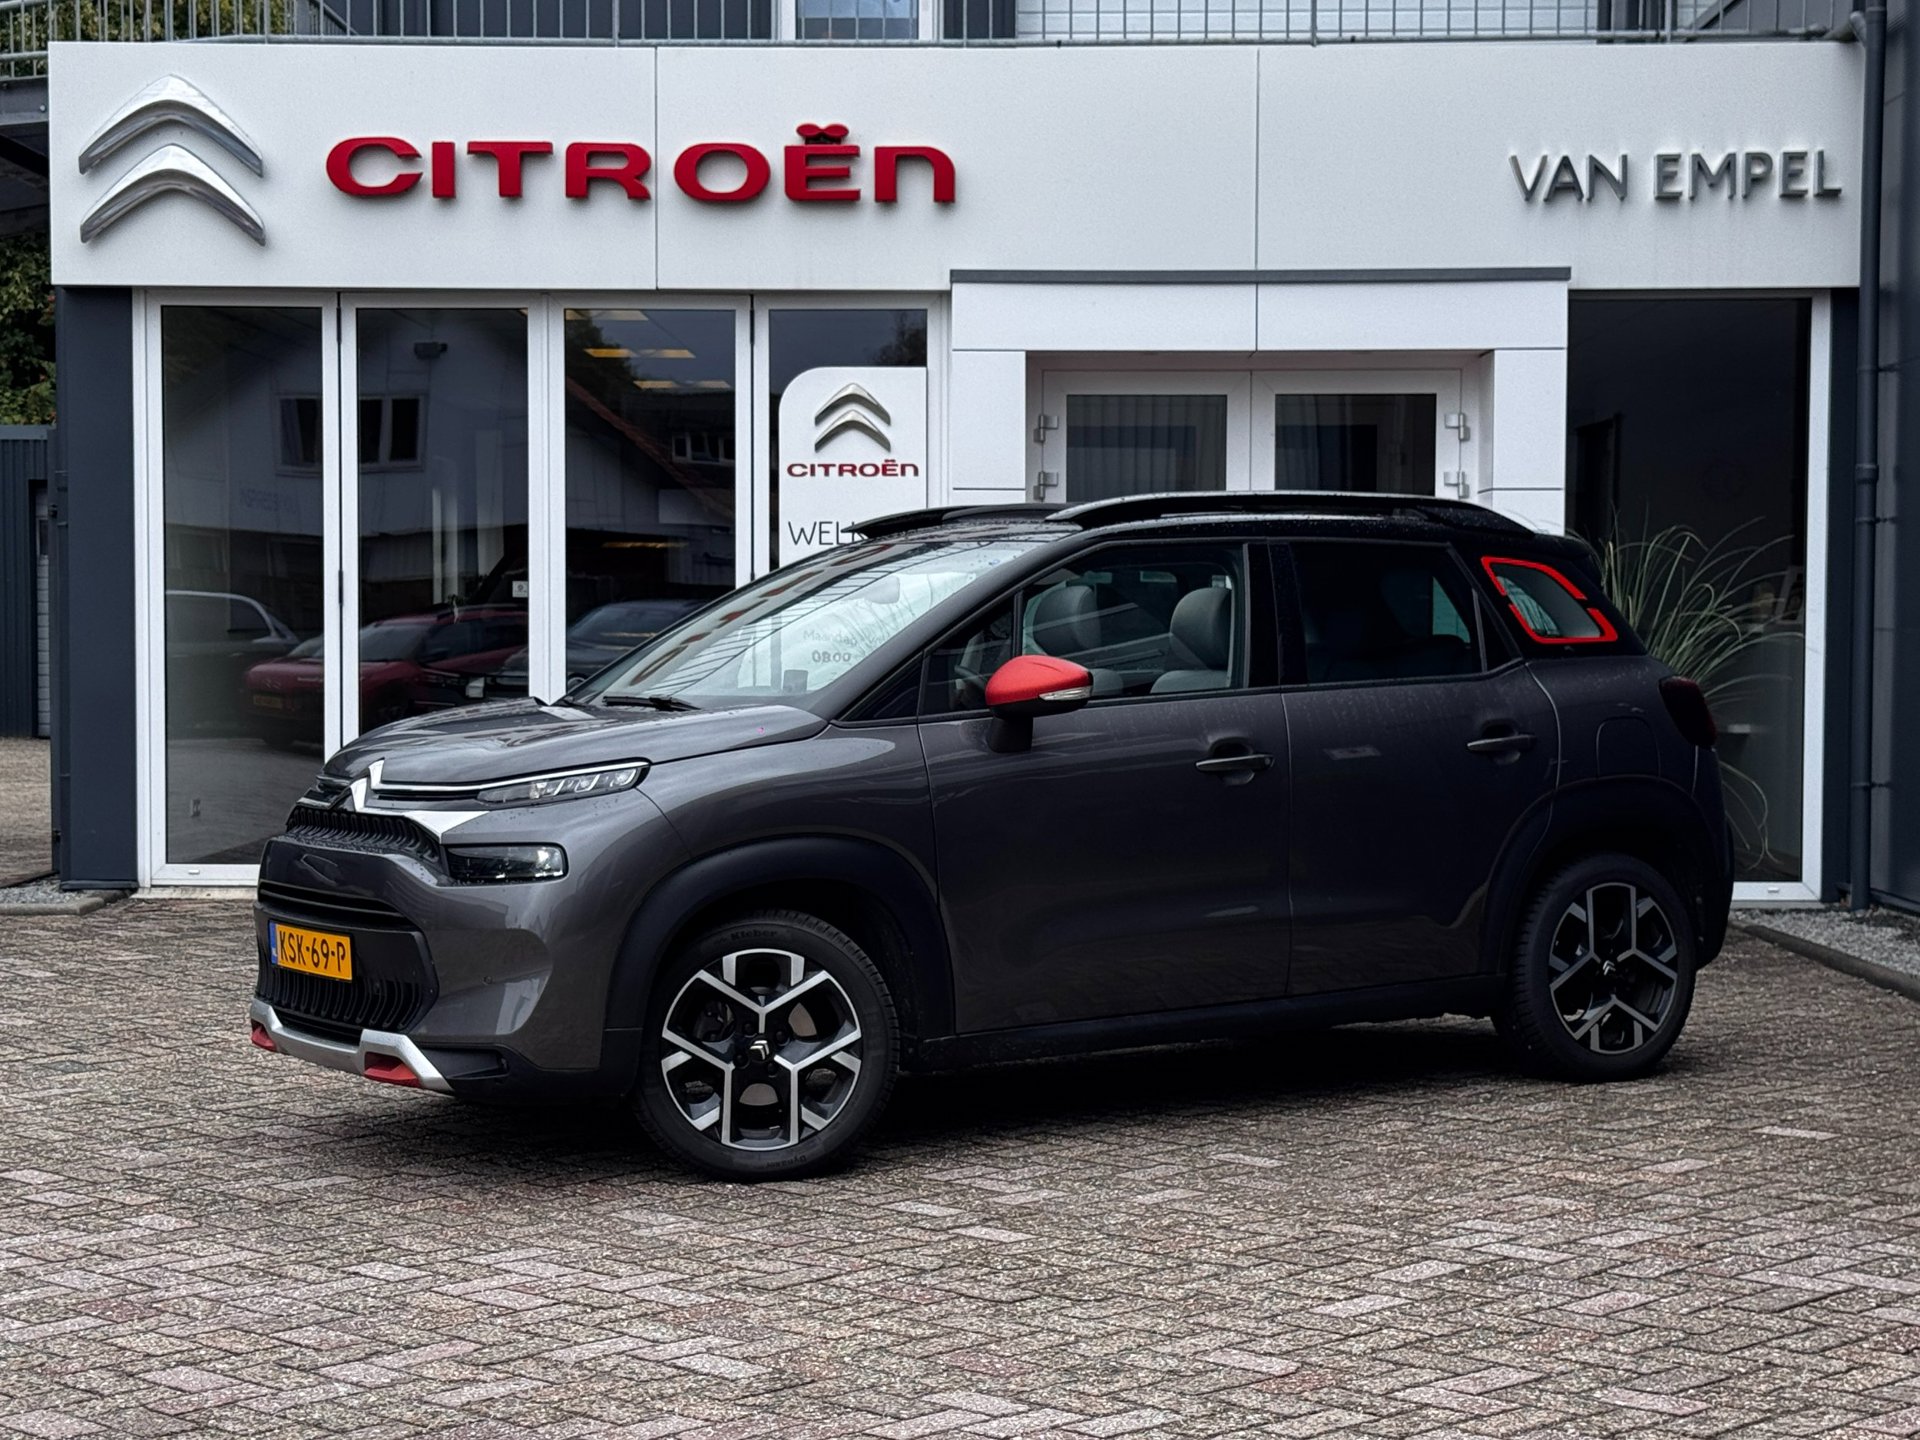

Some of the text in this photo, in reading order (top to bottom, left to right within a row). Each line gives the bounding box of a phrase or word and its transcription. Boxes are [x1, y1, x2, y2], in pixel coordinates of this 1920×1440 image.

[1508, 149, 1842, 202] VAN EMPEL
[279, 930, 346, 973] KSK-69-P
